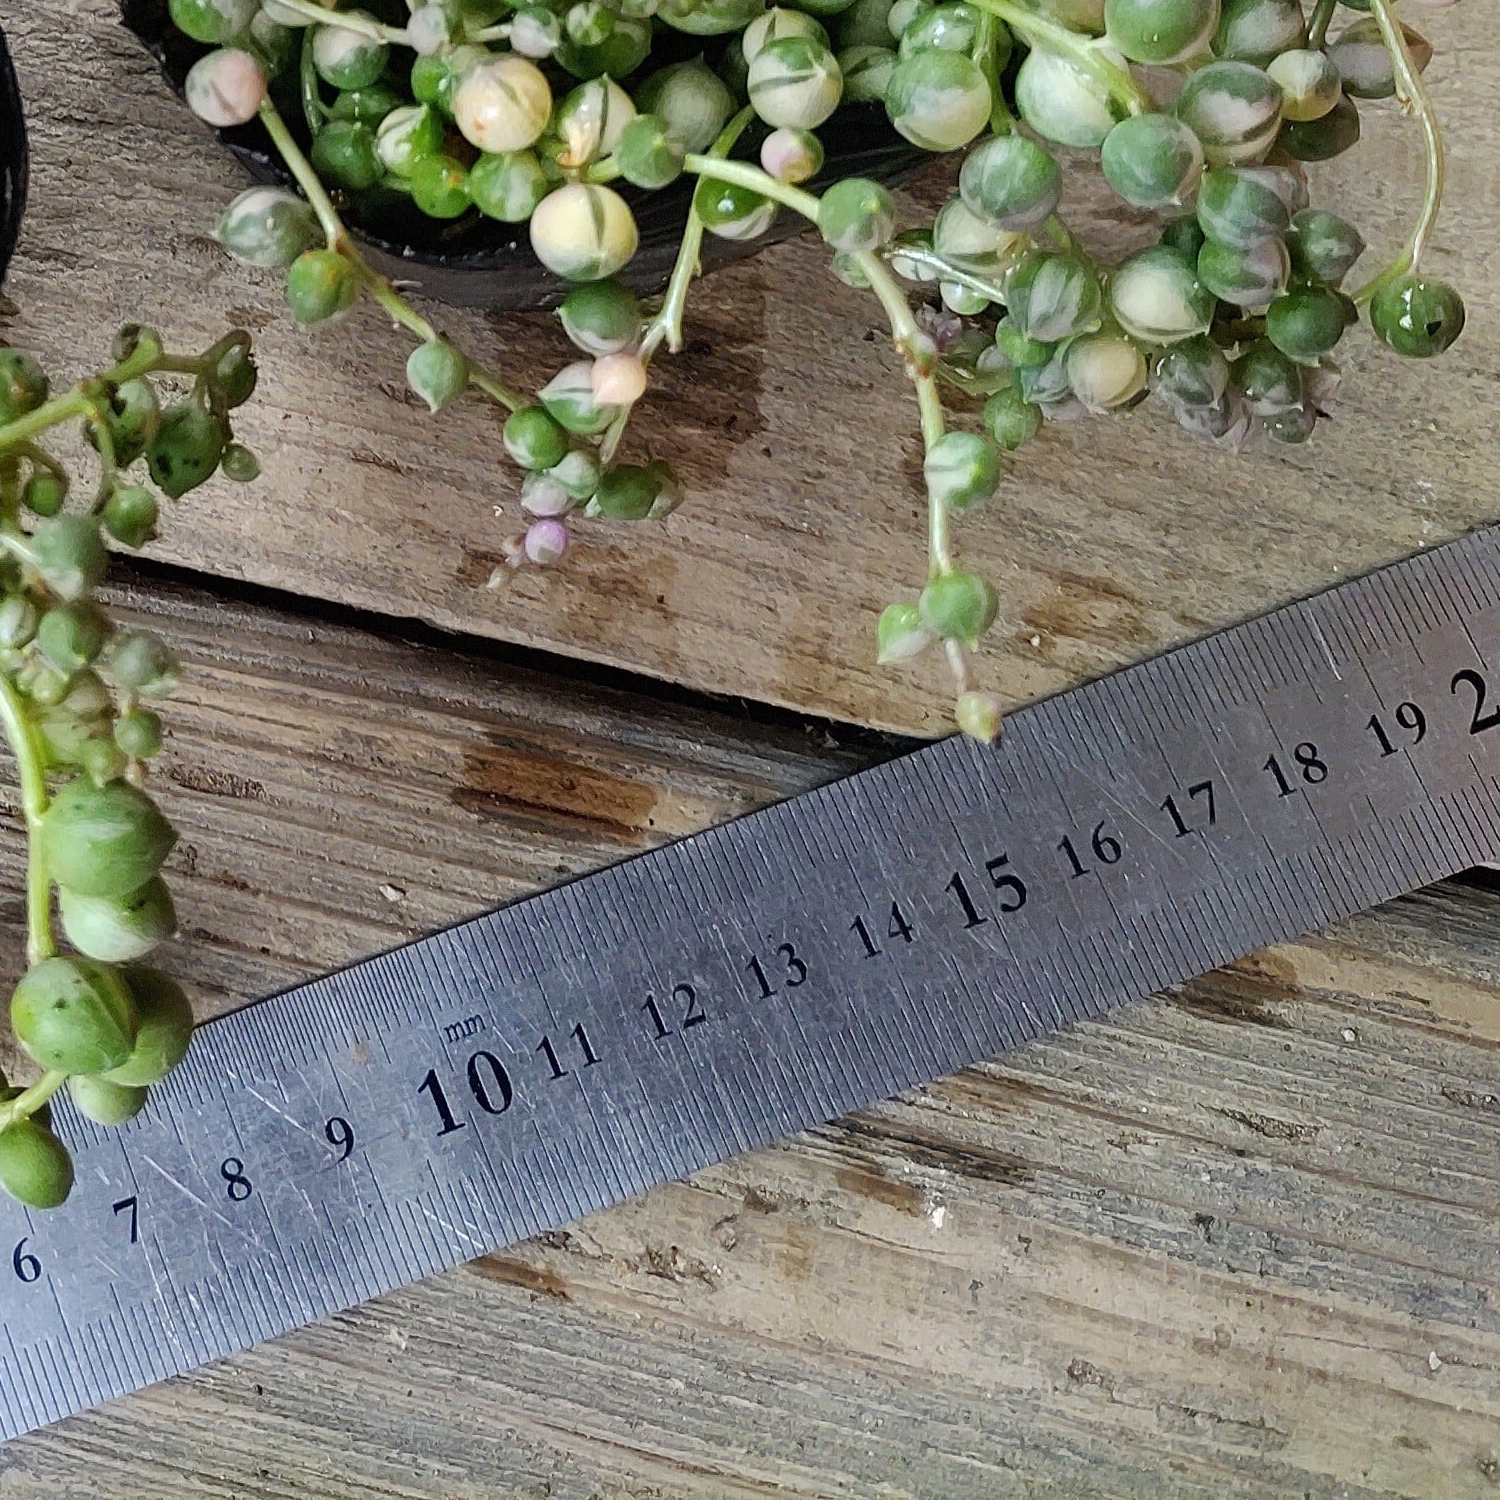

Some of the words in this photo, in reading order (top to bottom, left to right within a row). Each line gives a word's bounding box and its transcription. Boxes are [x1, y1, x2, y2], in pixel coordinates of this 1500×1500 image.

[13, 1236, 42, 1283] 6
[112, 1195, 140, 1244] 7
[220, 1156, 253, 1201] 8
[325, 1116, 356, 1163] 9
[417, 1049, 514, 1137] 10
[534, 1022, 603, 1080] 11
[639, 983, 707, 1040] 12
[744, 942, 808, 1000] 13
[849, 901, 915, 959] 14
[944, 854, 1028, 931] 15
[1055, 820, 1122, 880] 16
[1158, 780, 1220, 839] 17
[1262, 741, 1329, 798] 18
[1363, 701, 1429, 758] 19
[442, 1013, 488, 1044] mm
